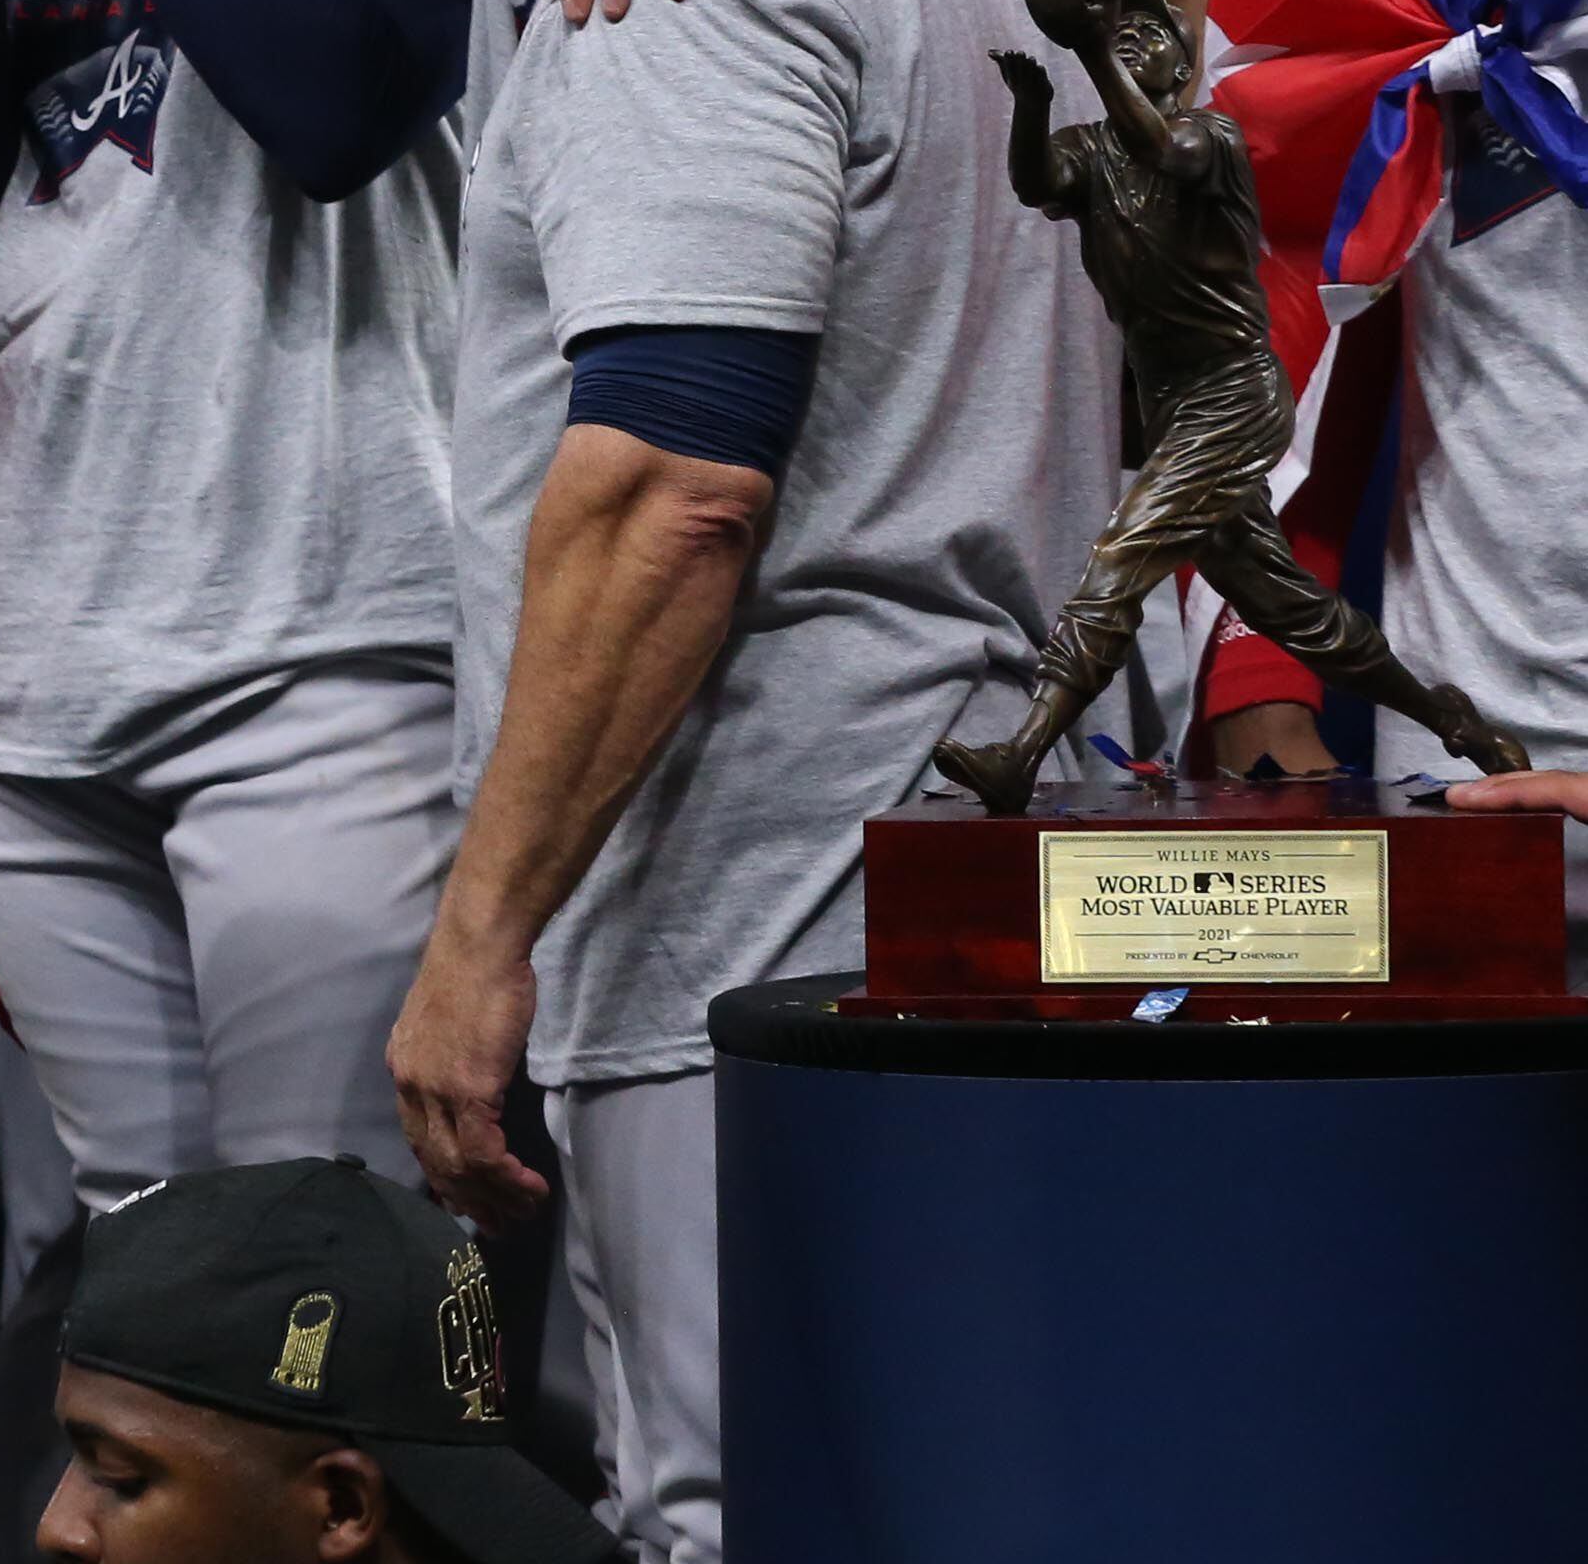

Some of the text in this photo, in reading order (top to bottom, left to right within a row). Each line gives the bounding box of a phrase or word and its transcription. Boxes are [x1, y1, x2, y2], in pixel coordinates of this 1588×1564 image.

[1157, 849, 1271, 862] WILLIE MAYS
[1096, 874, 1326, 895] WORLD SERIES
[1198, 929, 1231, 941] 2021
[1125, 952, 1177, 960] PRESENTED
[1240, 951, 1300, 960] CHEVROLET
